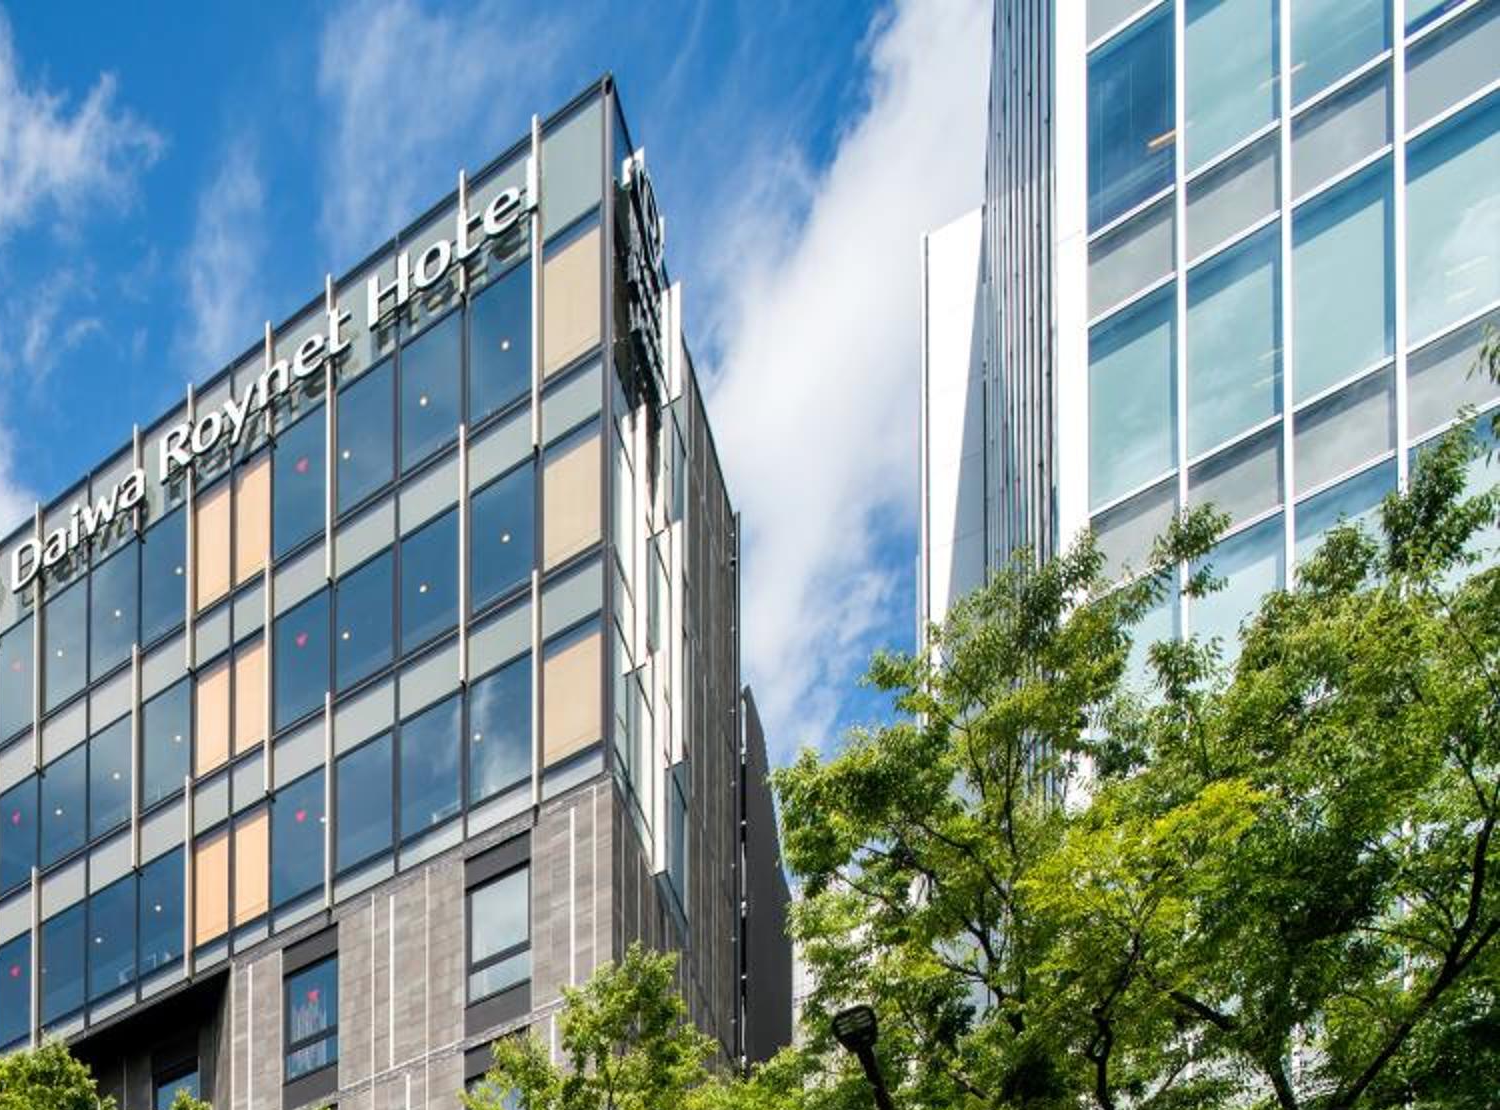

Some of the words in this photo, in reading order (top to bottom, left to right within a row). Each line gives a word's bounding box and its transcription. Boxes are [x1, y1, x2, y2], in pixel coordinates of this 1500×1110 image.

[11, 468, 146, 592] Daiwa
[160, 308, 352, 482] Roynet
[368, 154, 538, 329] Hotel
